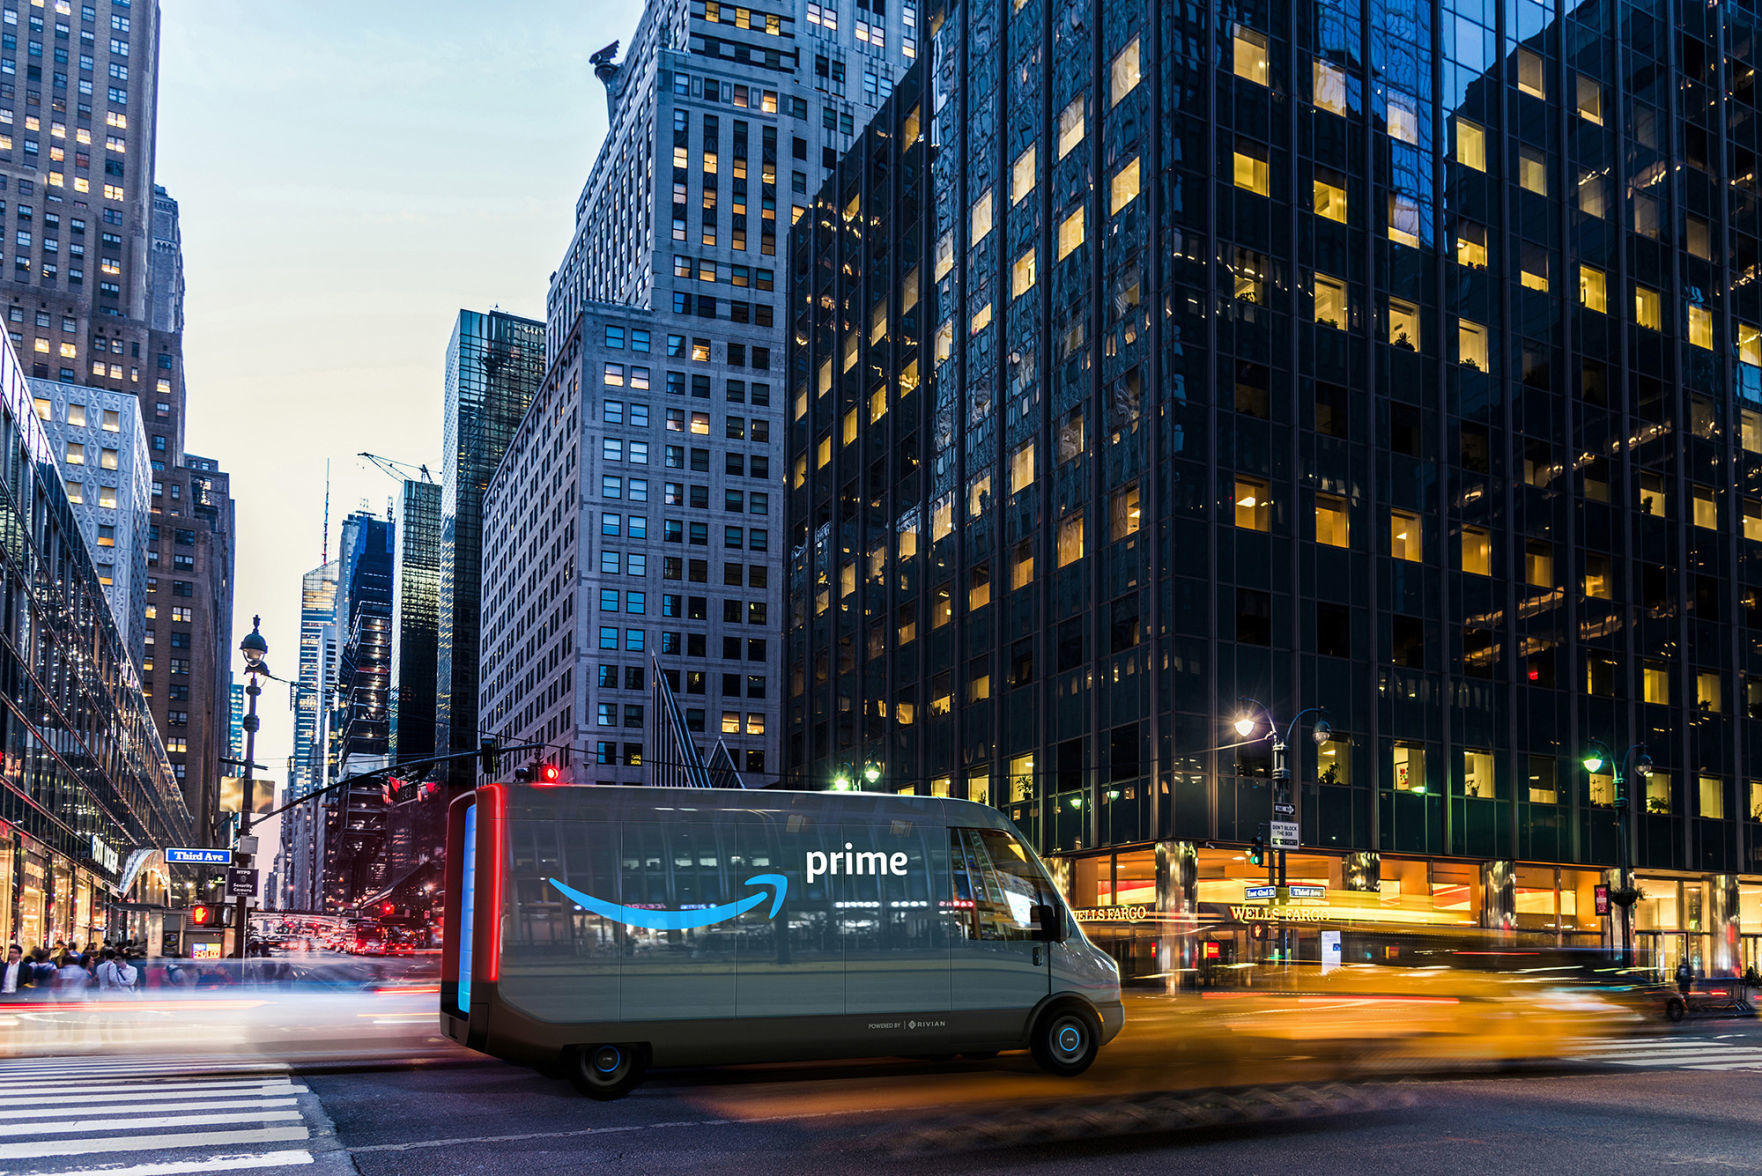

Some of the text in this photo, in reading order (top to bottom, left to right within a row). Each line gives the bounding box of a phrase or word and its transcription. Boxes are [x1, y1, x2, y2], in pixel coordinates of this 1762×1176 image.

[174, 851, 224, 861] Third Ave
[806, 842, 908, 884] prime
[1107, 906, 1147, 920] FARGO
[1229, 906, 1330, 921] WELLS FARGO
[917, 1020, 946, 1028] RIVIAN
